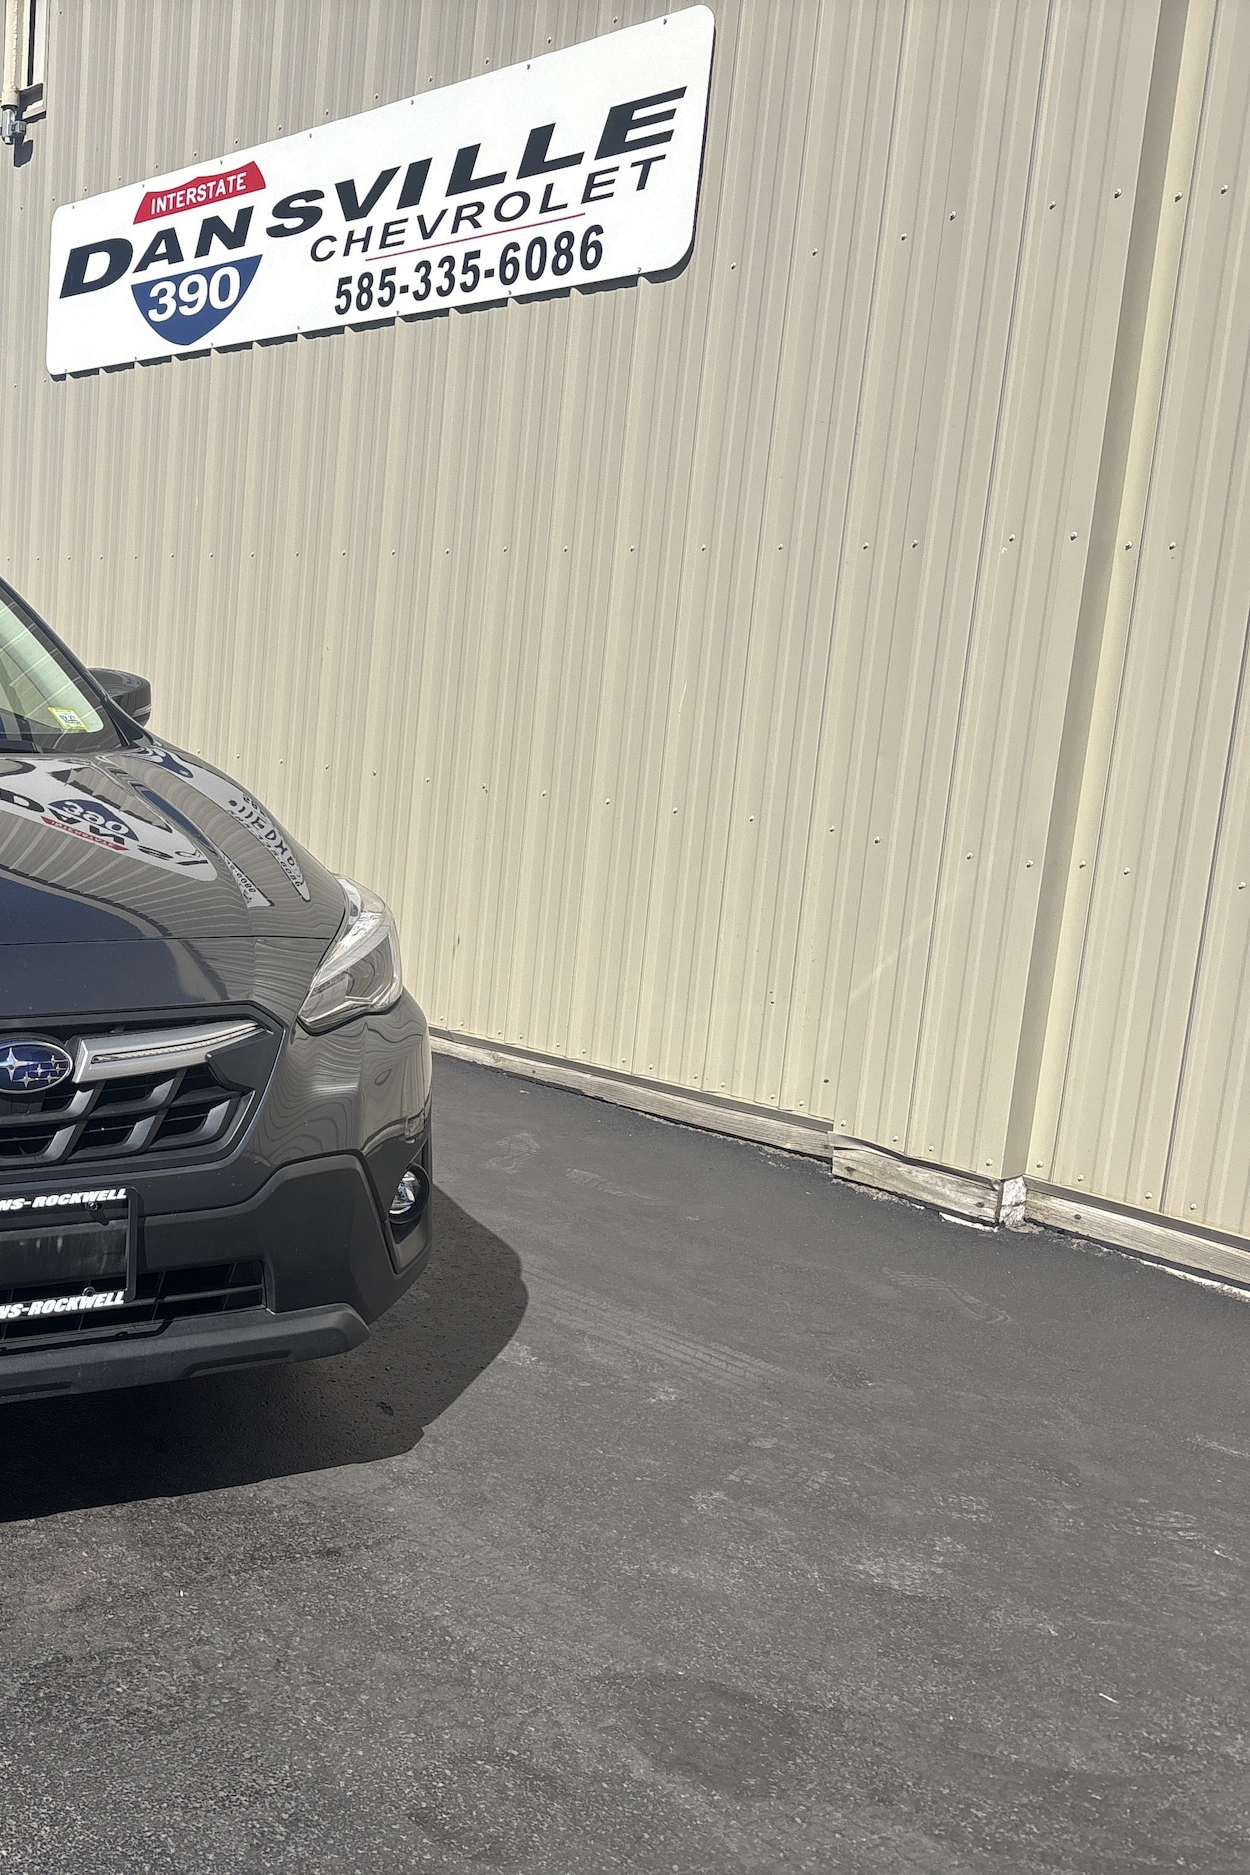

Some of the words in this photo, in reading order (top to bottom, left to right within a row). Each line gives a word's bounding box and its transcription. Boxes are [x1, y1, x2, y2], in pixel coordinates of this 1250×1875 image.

[149, 172, 248, 215] INTERSTATE
[309, 155, 667, 263] CHEVROLET
[147, 272, 241, 324] 390
[334, 224, 604, 316] 585-335-6086
